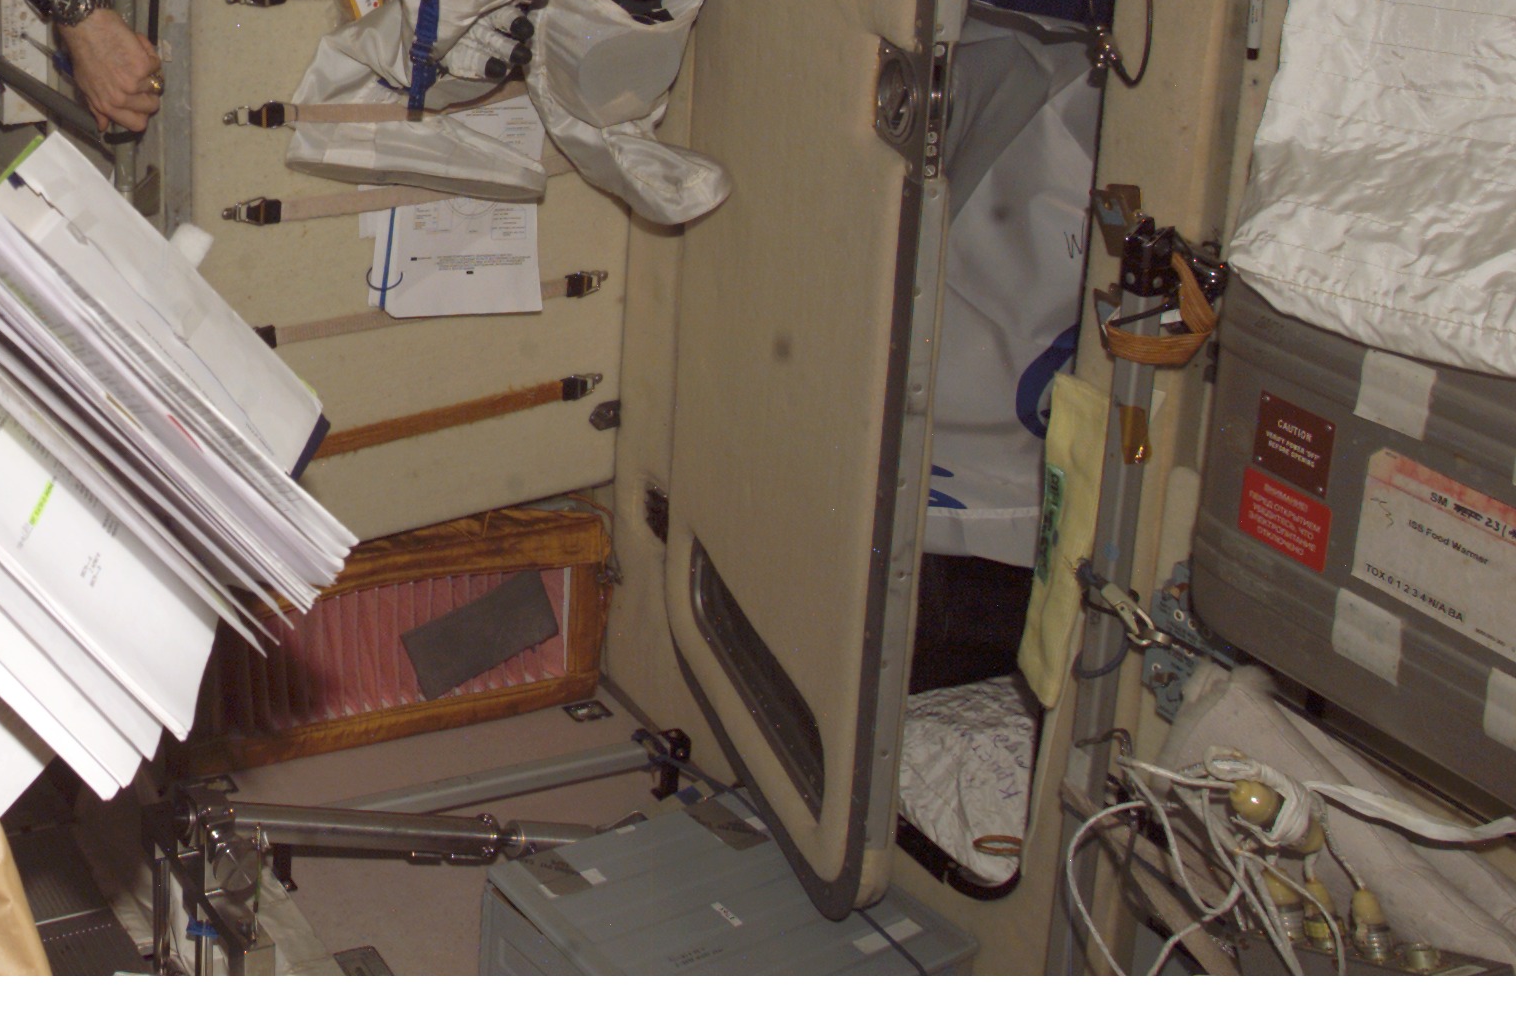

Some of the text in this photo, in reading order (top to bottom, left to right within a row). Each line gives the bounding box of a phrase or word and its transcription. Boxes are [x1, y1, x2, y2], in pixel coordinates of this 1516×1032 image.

[1277, 418, 1312, 443] CAUTION
[1430, 491, 1447, 508] SM
[1408, 518, 1489, 565] ISS Food Warmer
[1365, 563, 1385, 580] TOX
